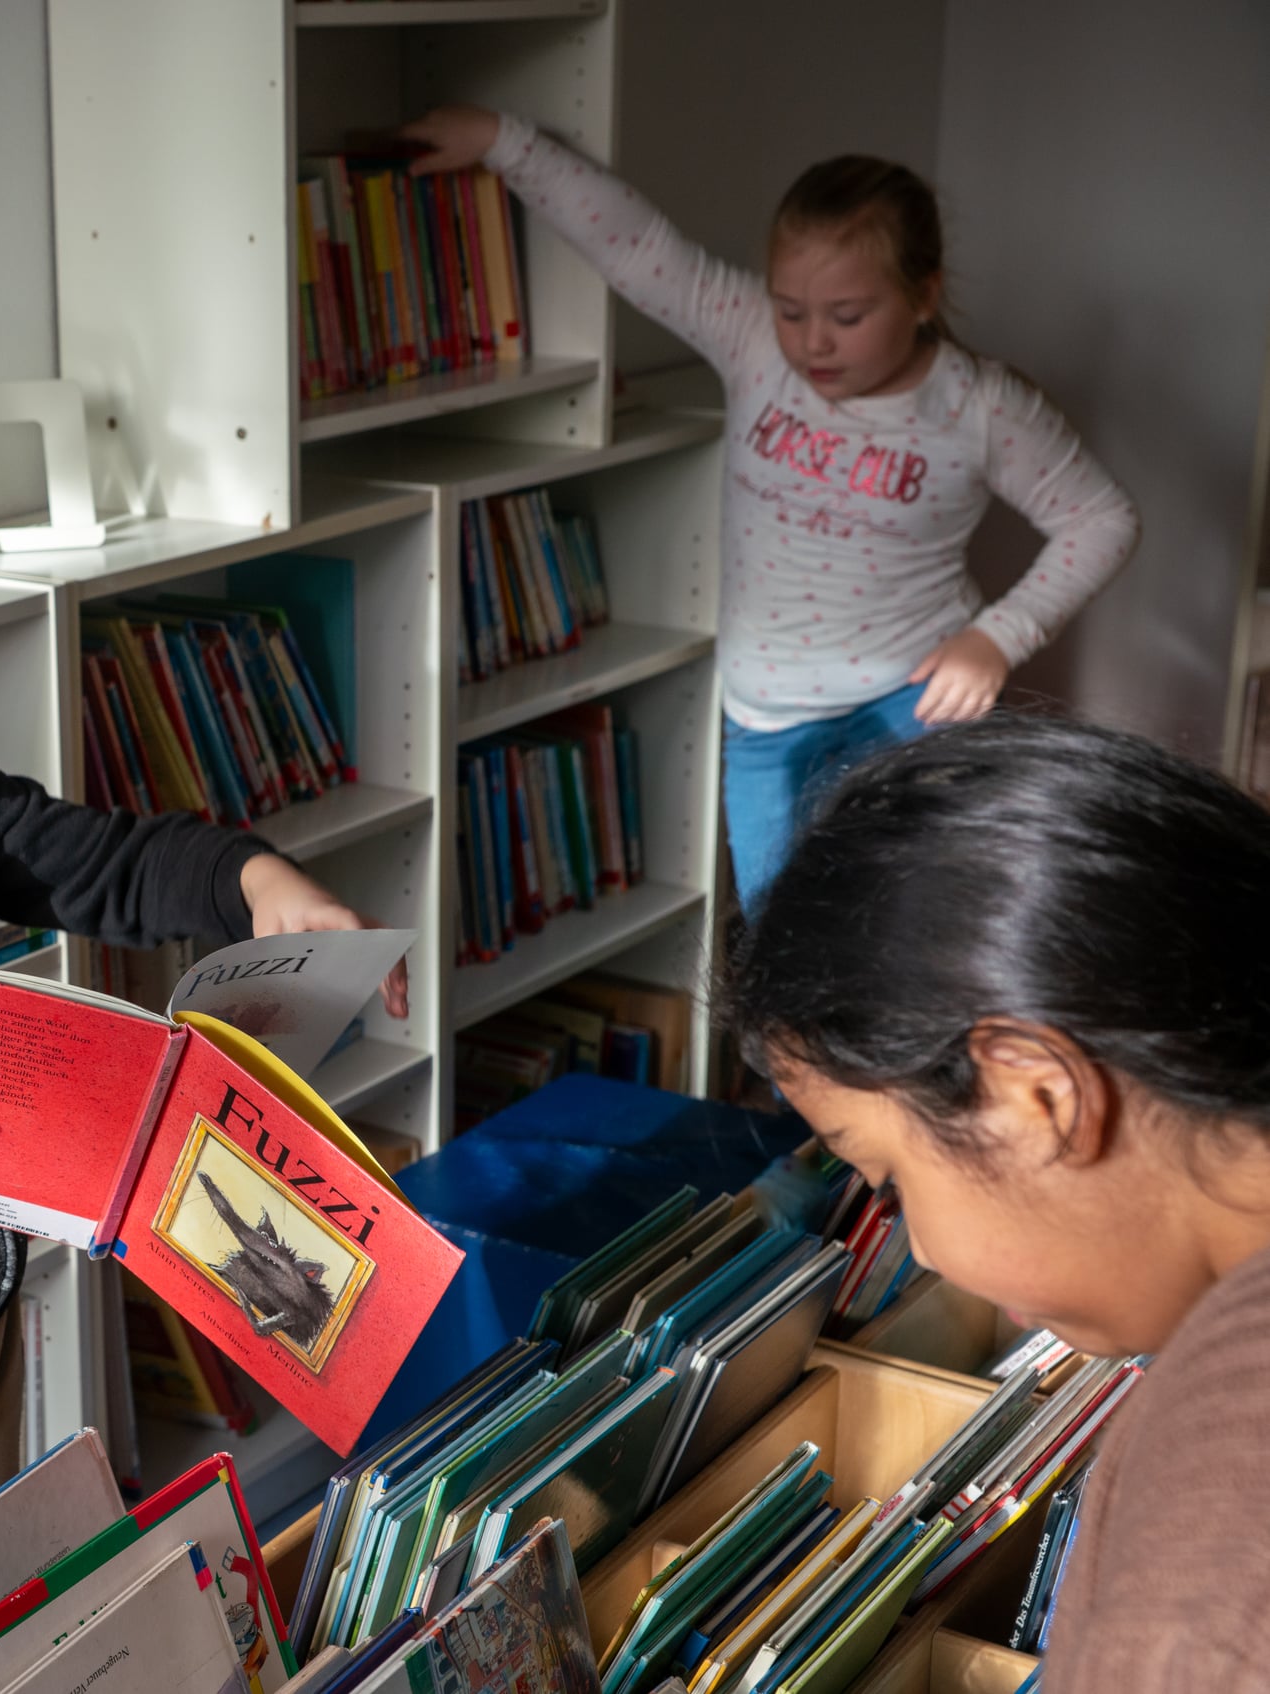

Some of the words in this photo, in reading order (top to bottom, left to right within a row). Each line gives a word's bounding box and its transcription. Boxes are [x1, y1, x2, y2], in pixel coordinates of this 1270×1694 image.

[744, 401, 848, 484] HORSE
[848, 443, 928, 505] CLUB
[184, 949, 313, 1000] Fuzzi
[210, 1080, 380, 1250] Fuzzi
[146, 1241, 177, 1270] Alain
[179, 1267, 216, 1304] Serres
[200, 1311, 252, 1356] Altberliner
[1015, 1608, 1028, 1629] Das
[1022, 1532, 1051, 1609] Traumfresserchen
[86, 1646, 131, 1688] Neugebauer
